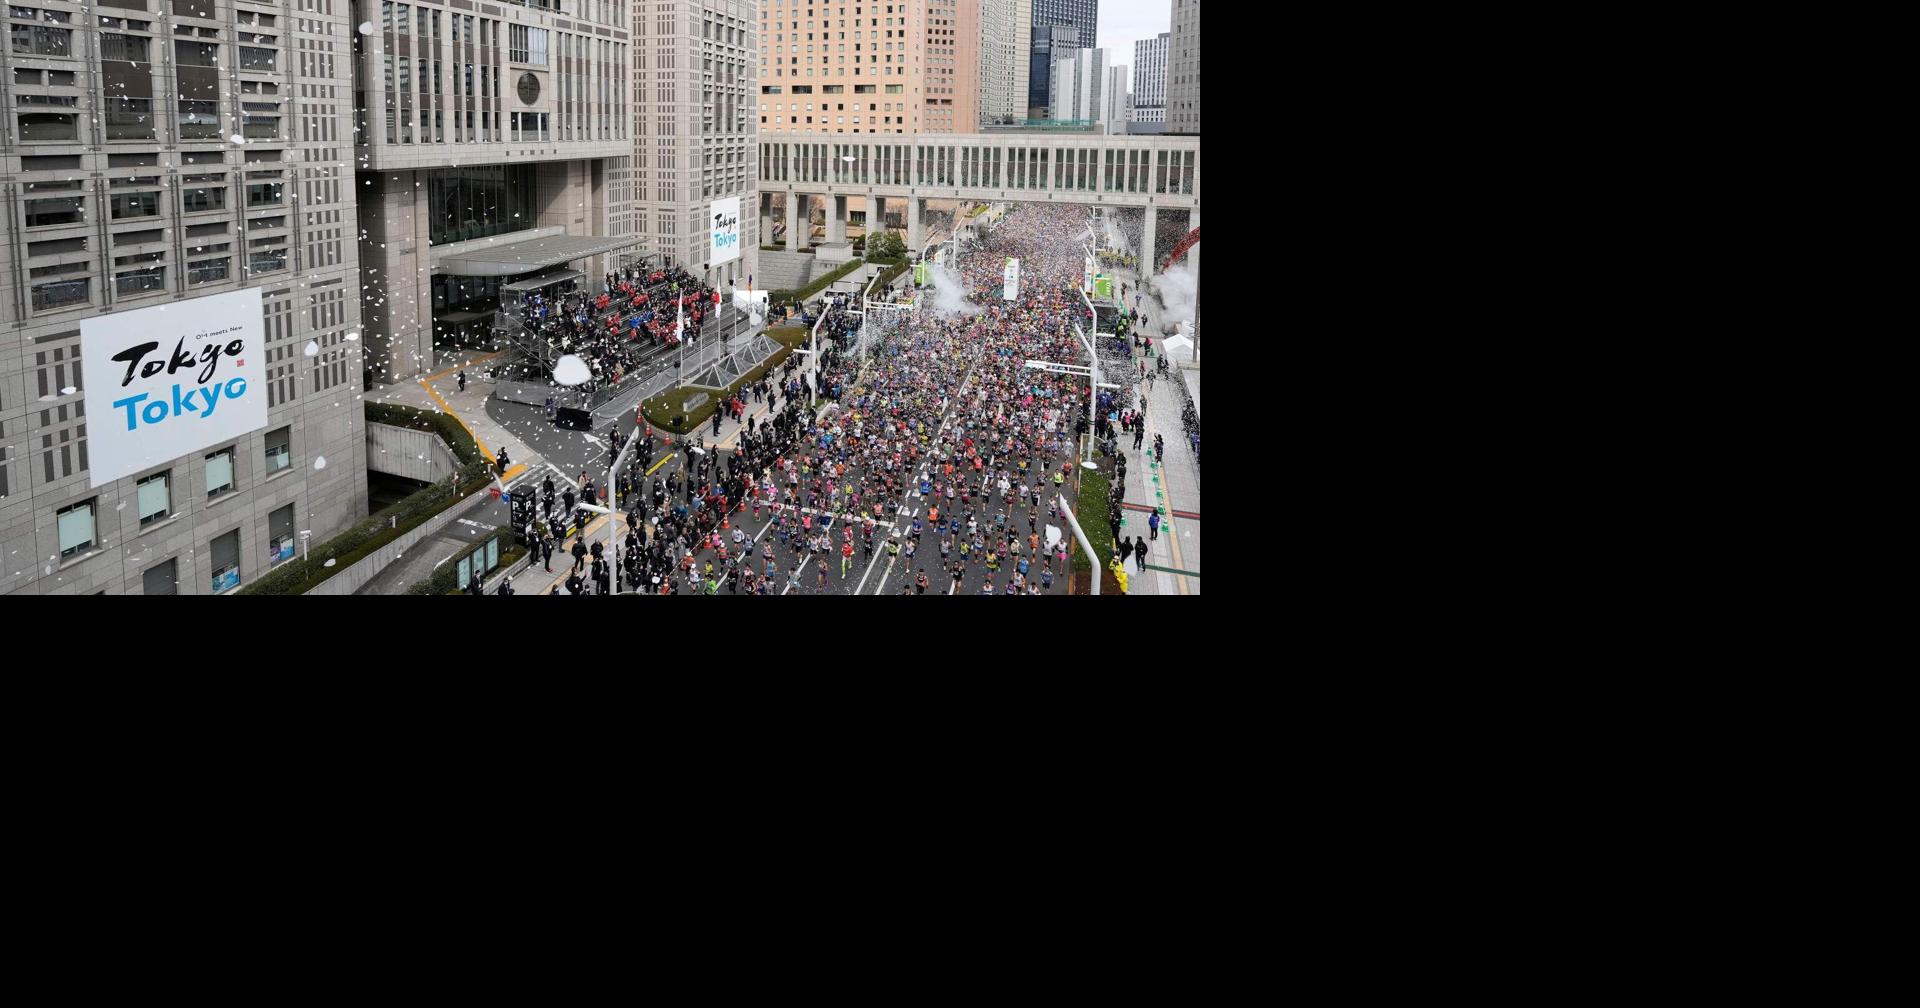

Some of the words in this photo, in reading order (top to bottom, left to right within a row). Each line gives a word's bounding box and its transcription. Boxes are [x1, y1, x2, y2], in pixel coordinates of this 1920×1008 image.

[714, 213, 736, 233] Tokyo
[714, 232, 736, 247] Tokyo
[209, 329, 228, 337] meets
[111, 336, 245, 387] Tokyo
[113, 377, 247, 431] Tokyo
[512, 501, 519, 510] P
[525, 500, 531, 511] P
